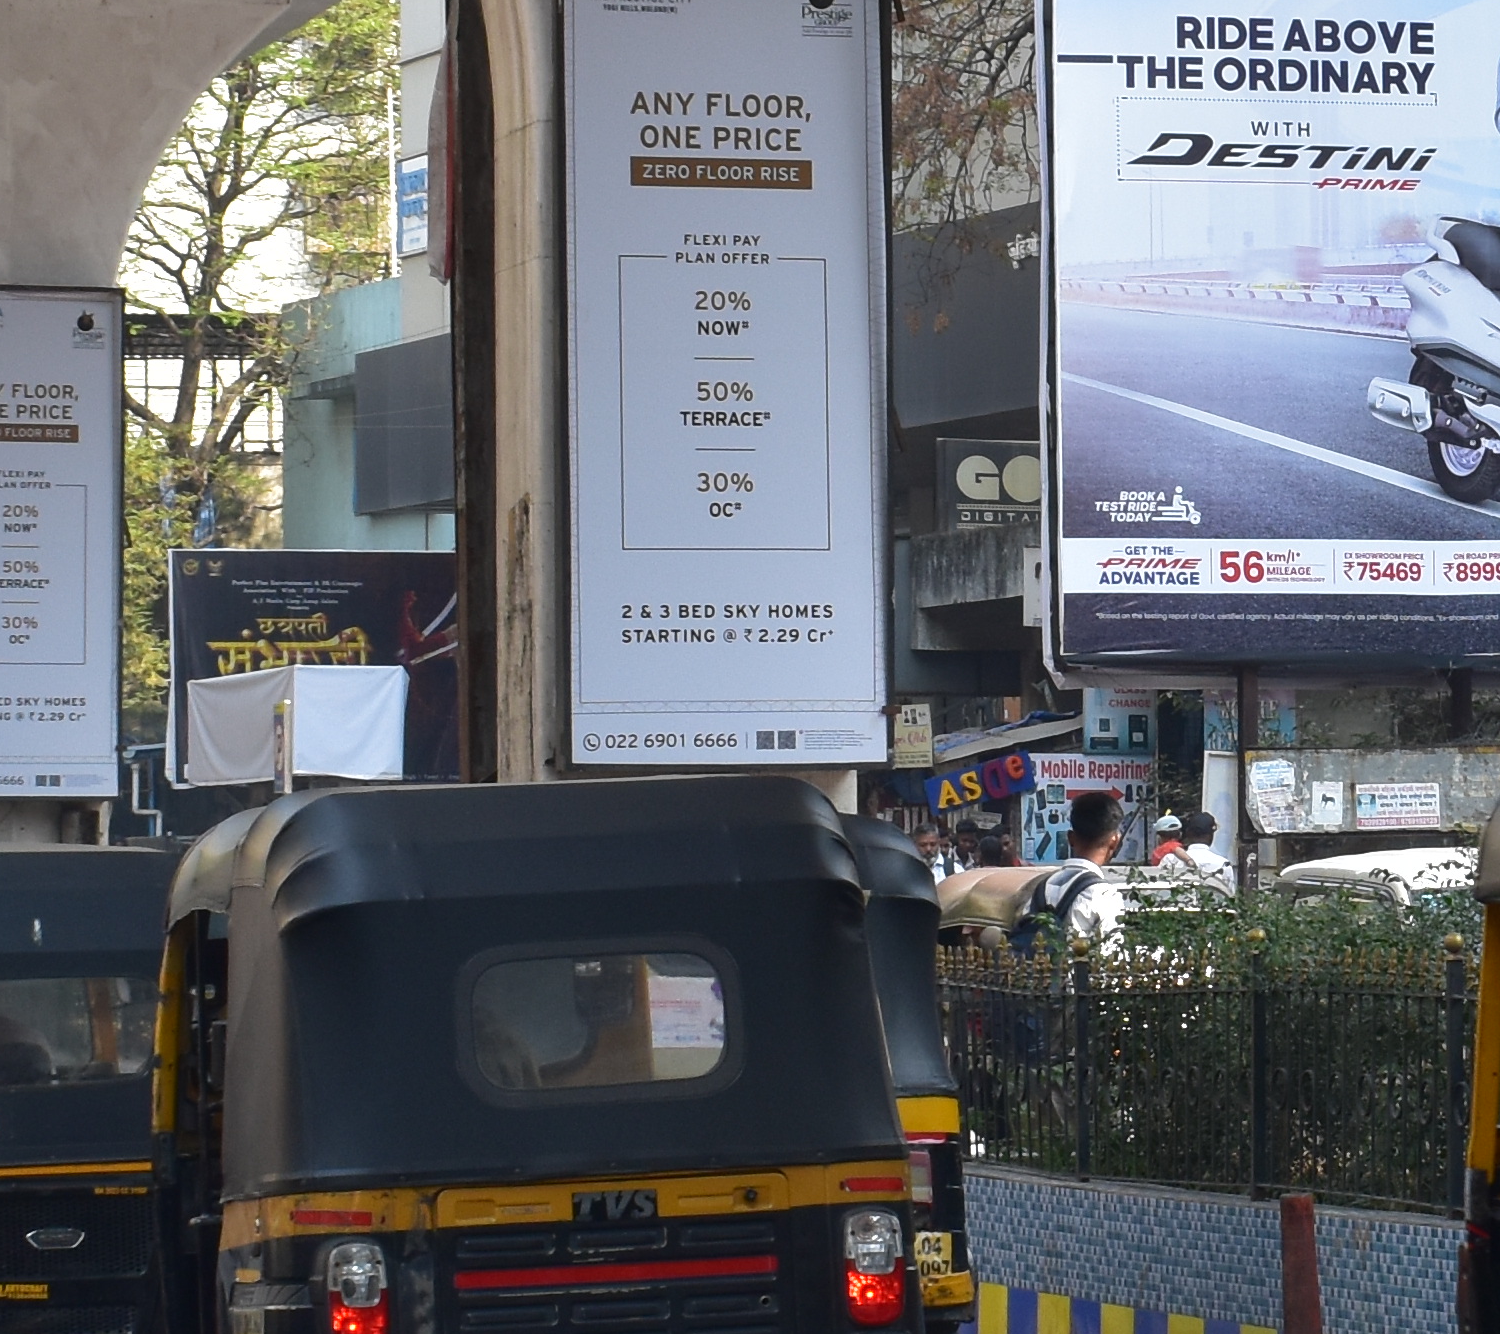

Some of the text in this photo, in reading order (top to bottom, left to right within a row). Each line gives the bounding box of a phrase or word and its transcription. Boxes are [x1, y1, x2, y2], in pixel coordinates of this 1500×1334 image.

[802, 4, 852, 24] Prestige
[1177, 16, 1434, 54] RIDE ABOVE
[1117, 56, 1435, 94] THE ORDINARY
[630, 92, 810, 122] ANY FLOOR,
[1251, 121, 1310, 137] WITH
[640, 125, 801, 151] ONE PRICE
[643, 164, 799, 181] ZERO FLOOR RISE
[1313, 176, 1423, 192] PRIME
[683, 232, 760, 248] FLEXI PAY
[676, 252, 769, 264] PLAN OFFER
[695, 291, 750, 310] 20%
[698, 321, 749, 335] NOW#
[12, 384, 78, 401] FLOOR,
[698, 382, 753, 401] 50%
[16, 405, 72, 419] PRICE
[680, 412, 770, 426] TERRACE#
[5, 428, 42, 437] FLOOR
[46, 429, 70, 438] RISE
[697, 473, 753, 492] 30%
[1120, 491, 1165, 501] BOOK A
[3, 505, 38, 517] 20%
[710, 503, 741, 517] OC#
[1095, 501, 1157, 512] TEST RIDE
[1109, 512, 1152, 523] TODAY
[1125, 546, 1173, 555] GET THE
[1453, 551, 1463, 560] ON
[1466, 551, 1485, 560] ROAD
[3, 561, 38, 573] 50%
[1097, 558, 1202, 570] PRIME
[1220, 551, 1264, 583] 56
[1099, 572, 1199, 585] ADVANTAGE
[1266, 566, 1311, 577] MILEAGE
[622, 605, 832, 618] 2 & 3 BED SKY HOMES
[2, 617, 38, 628] 30%
[622, 629, 714, 643] STARTING
[723, 629, 736, 643] @
[759, 629, 799, 642] 2.29
[1108, 699, 1151, 708] CHANGE
[606, 733, 737, 748] 022 6901 6666
[1041, 760, 1085, 779] Mobile
[573, 1190, 657, 1221] TVS
